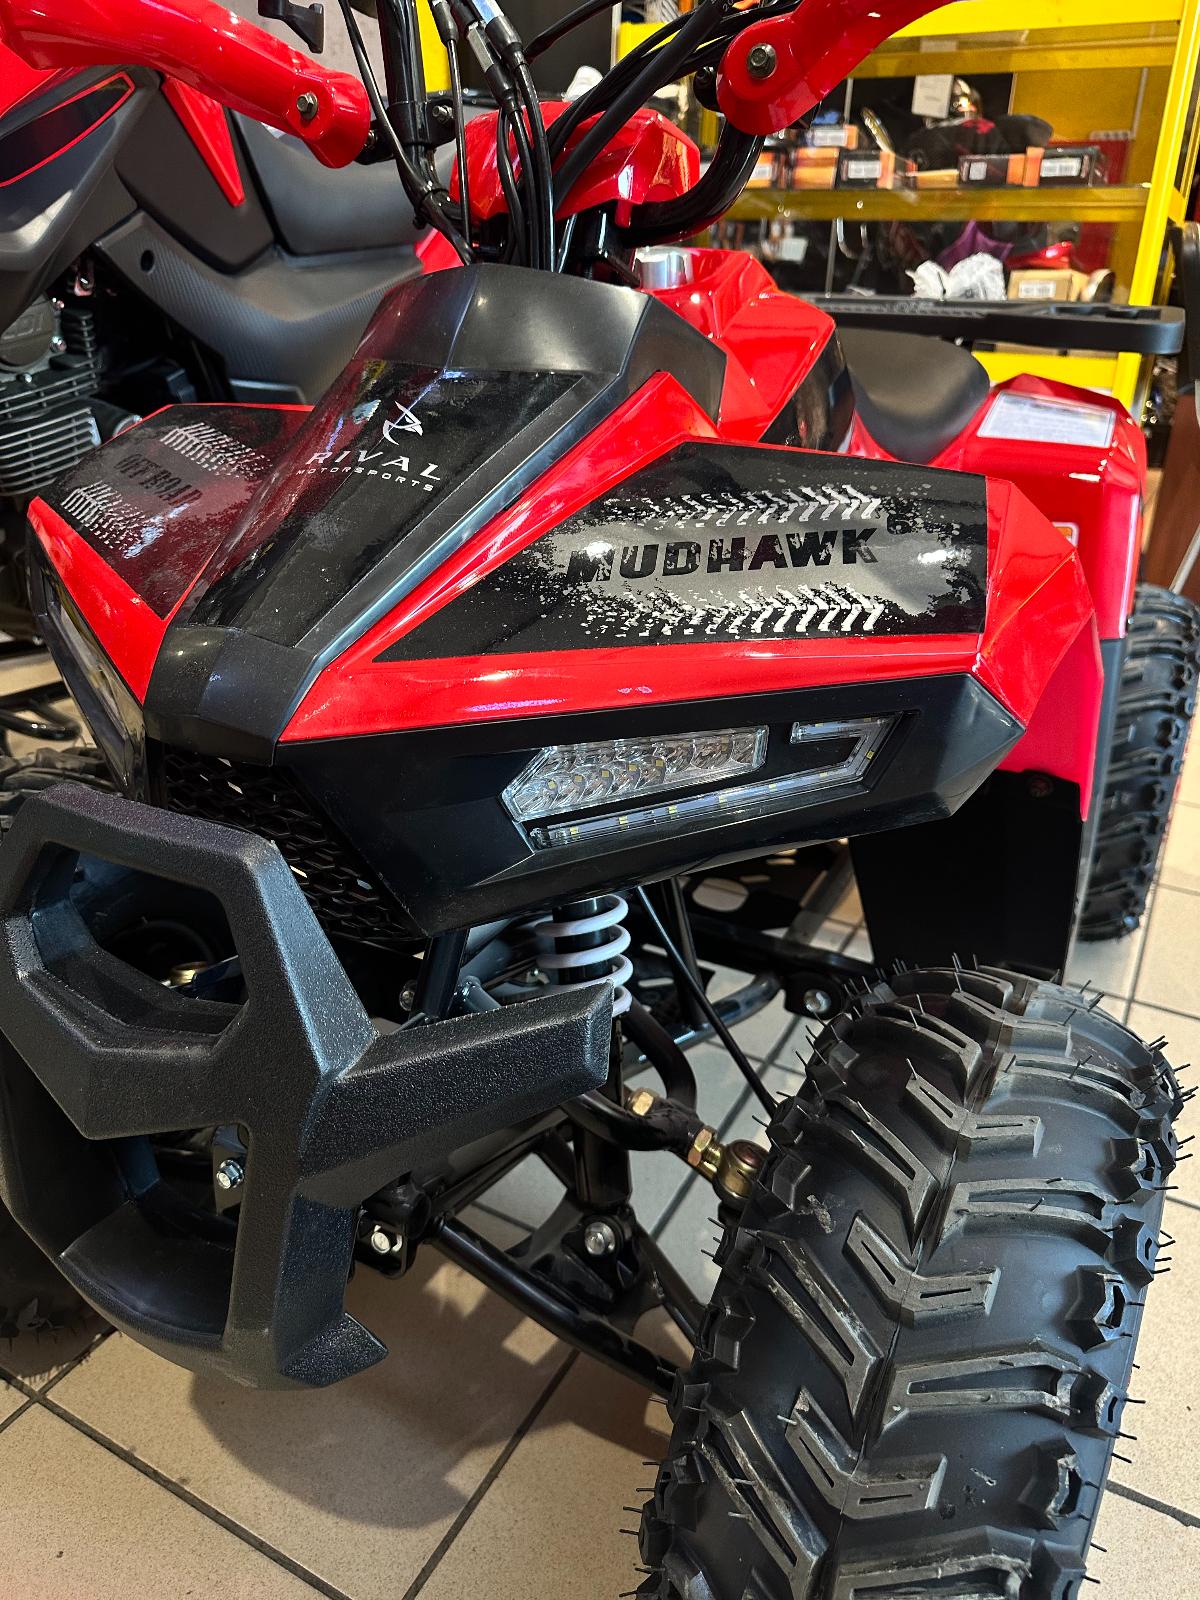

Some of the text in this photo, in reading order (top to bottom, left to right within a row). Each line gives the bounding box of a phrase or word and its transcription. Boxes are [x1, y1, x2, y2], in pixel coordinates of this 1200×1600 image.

[295, 466, 434, 492] MOTORSPORTS
[305, 450, 441, 481] RIVAL
[565, 527, 878, 582] MUDHAWK
